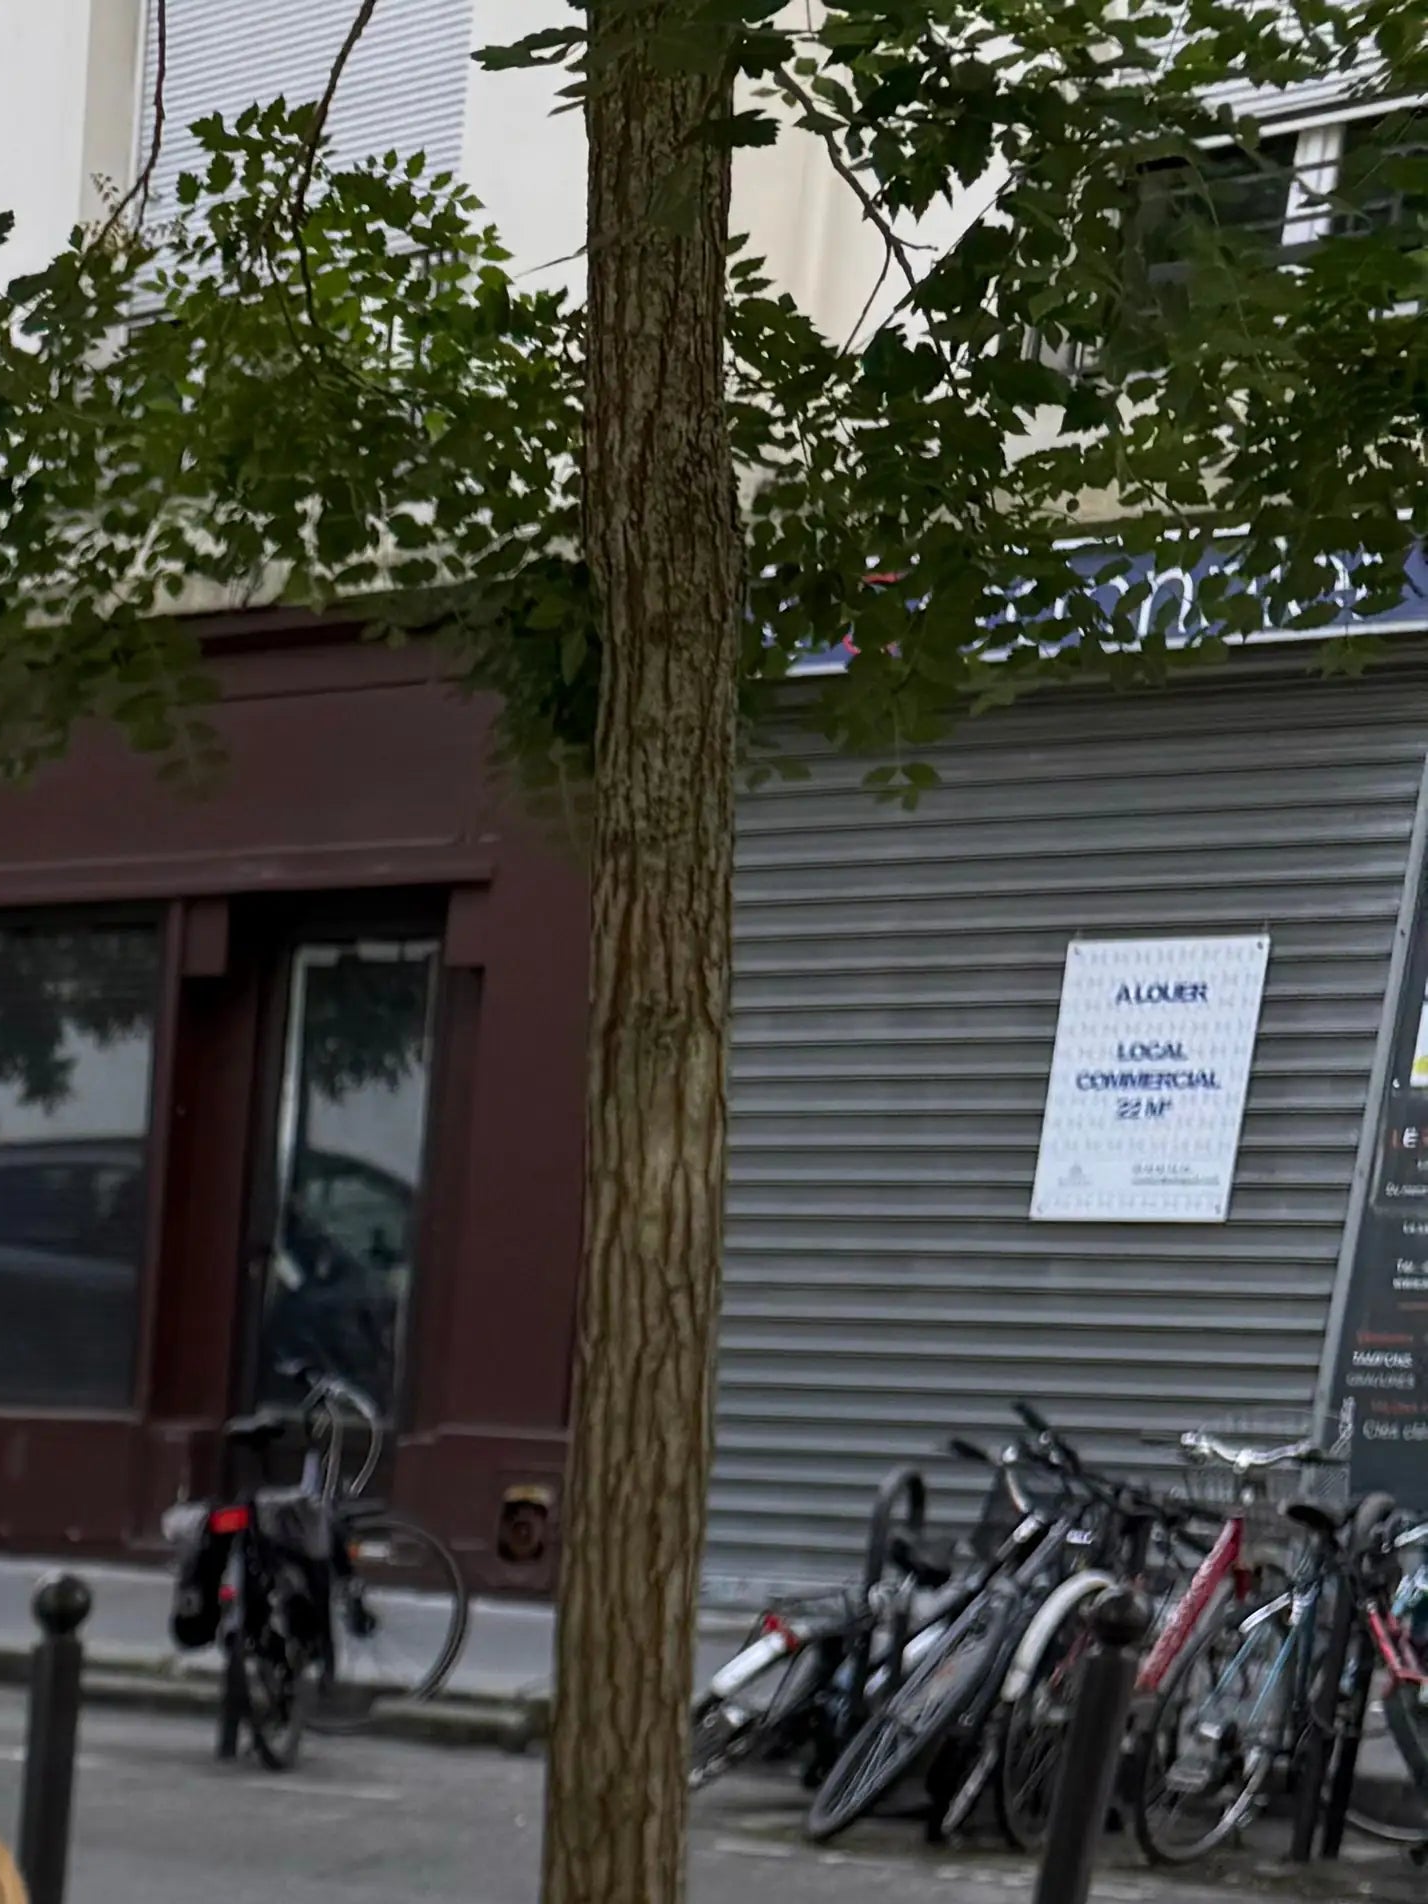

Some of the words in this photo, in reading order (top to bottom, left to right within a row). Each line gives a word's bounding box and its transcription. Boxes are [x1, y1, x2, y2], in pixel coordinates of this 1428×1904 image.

[1135, 981, 1208, 1004] LOUER
[1117, 1041, 1187, 1062] LOCAL
[1075, 1070, 1222, 1092] COMMERCIAL
